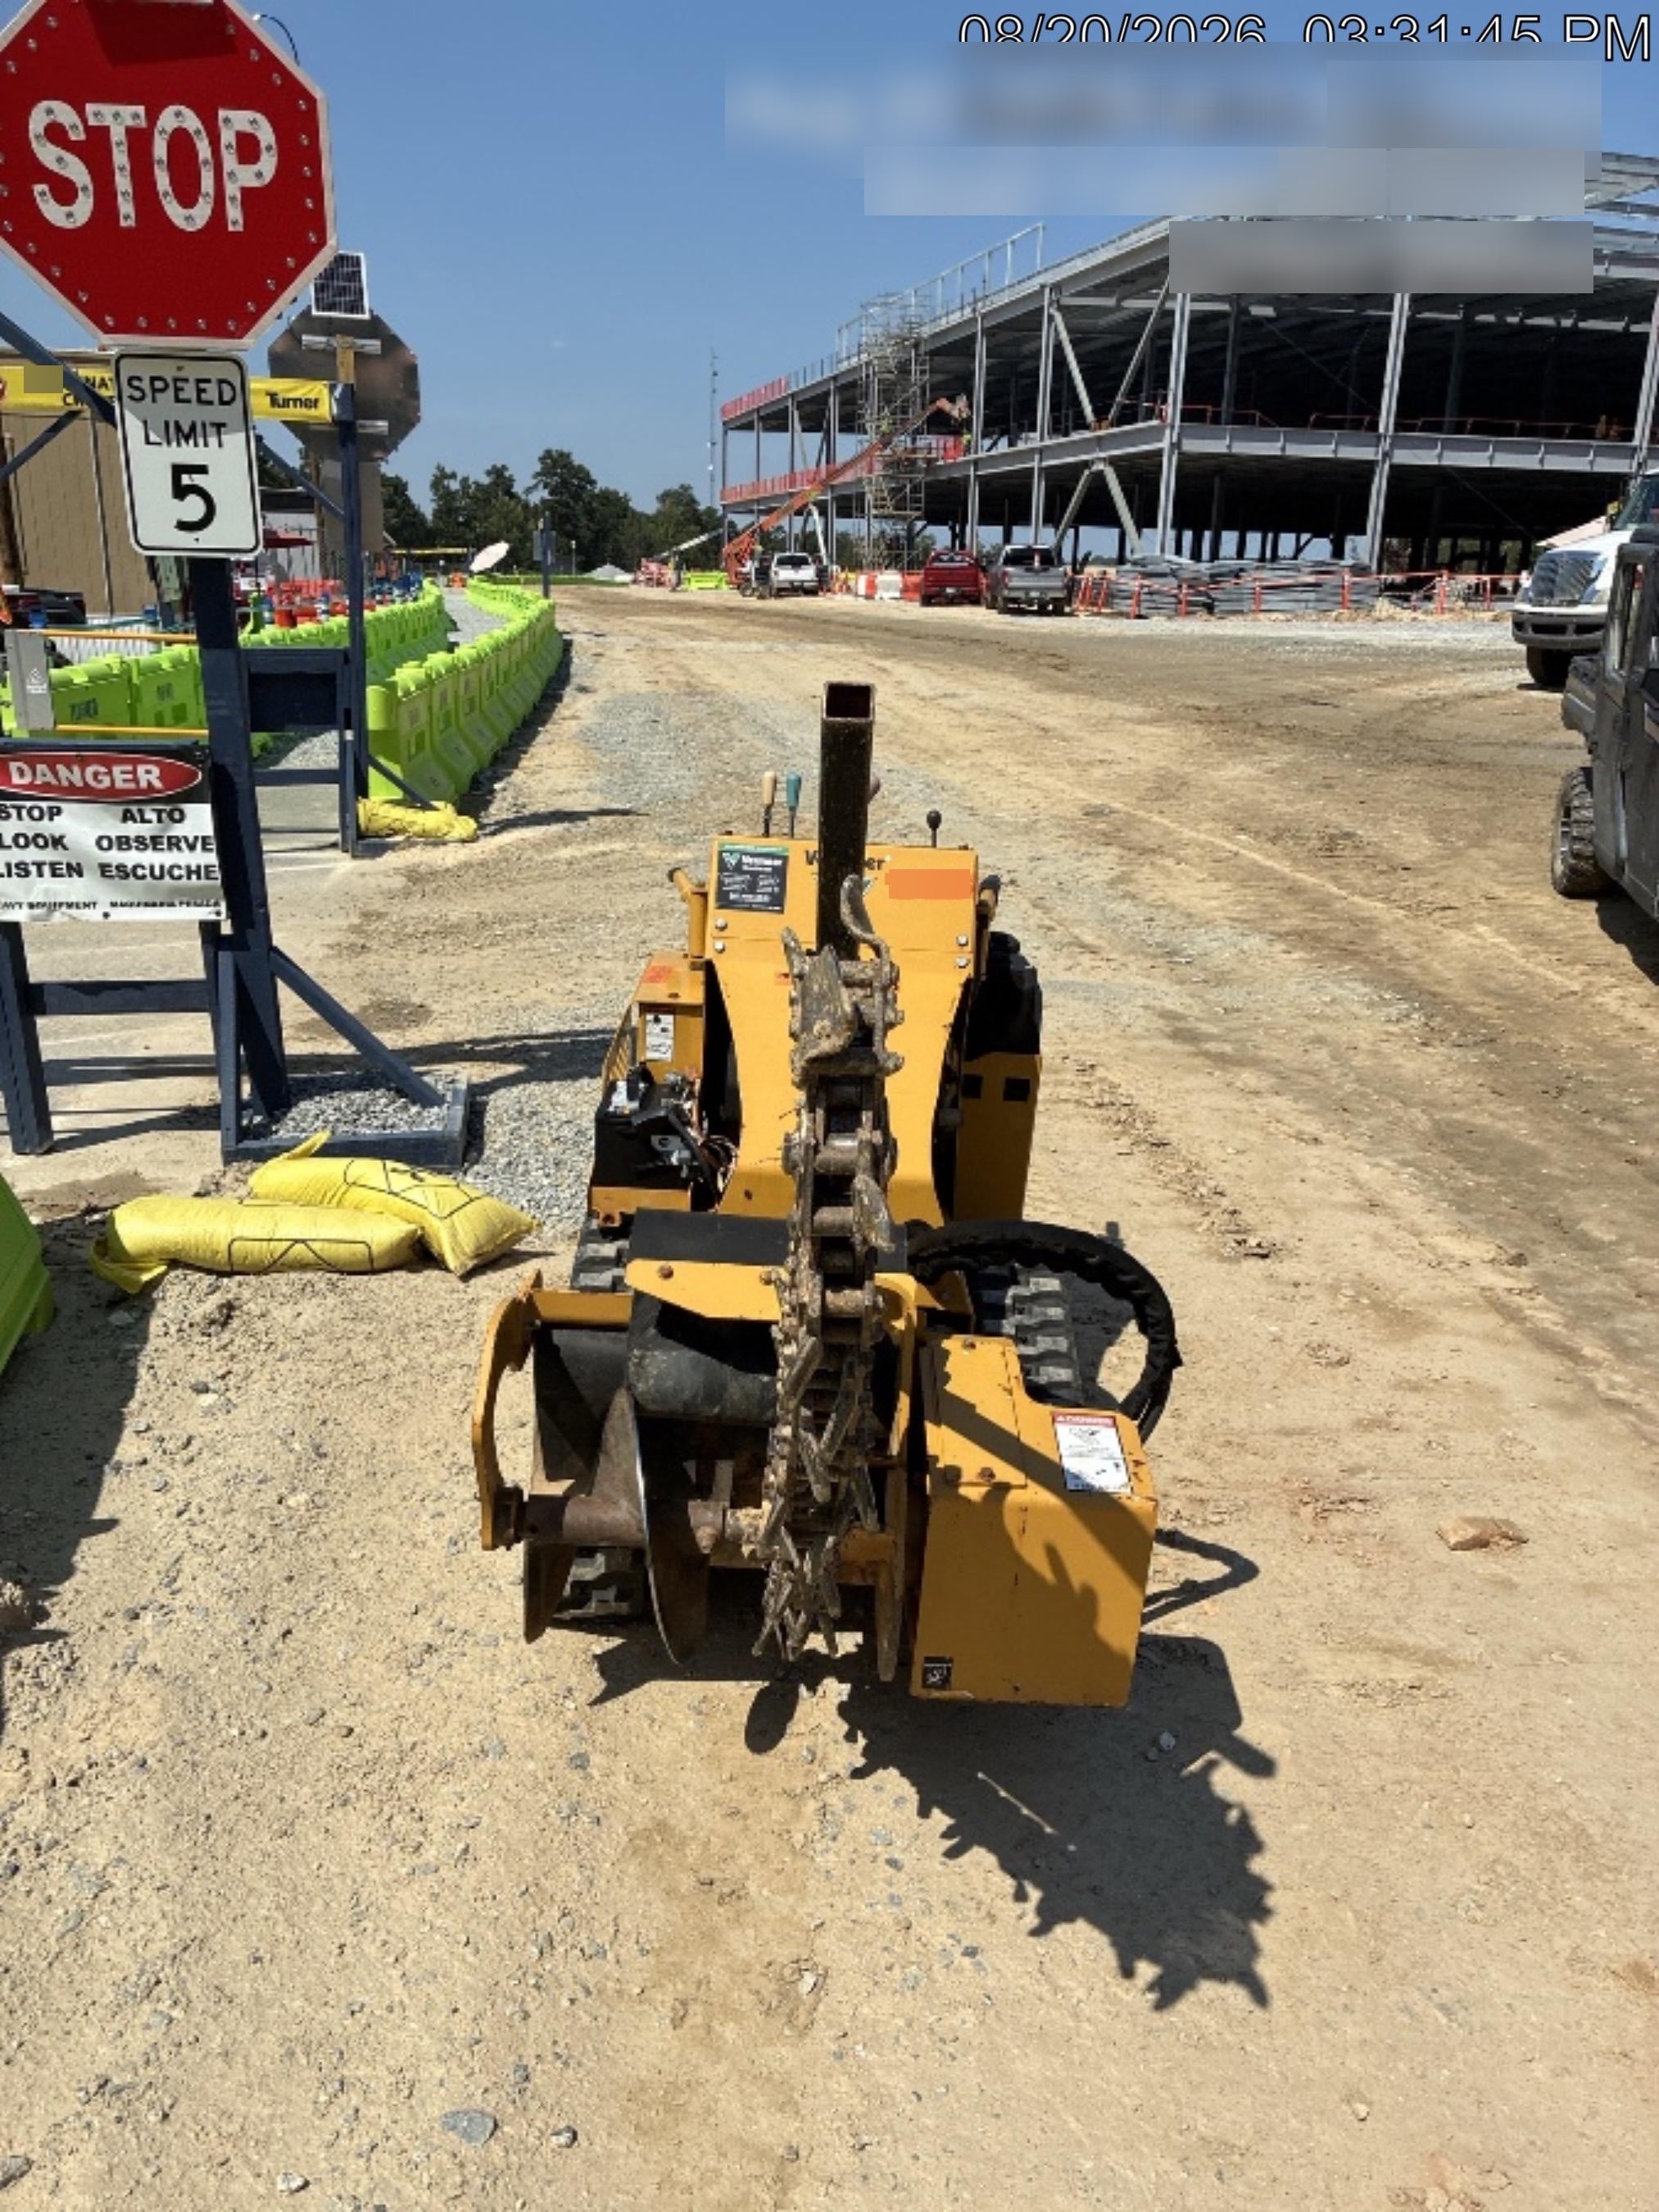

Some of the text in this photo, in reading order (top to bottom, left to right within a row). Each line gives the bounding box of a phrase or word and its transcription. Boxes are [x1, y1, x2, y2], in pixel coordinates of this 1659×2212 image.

[29, 101, 278, 231] STOP
[127, 375, 237, 406] SPEED
[265, 391, 320, 409] Turner
[143, 419, 227, 448] LIMIT
[171, 463, 216, 533] 5
[9, 761, 163, 789] DANGER
[0, 804, 62, 822] STOP
[121, 807, 185, 824] ALTO
[0, 832, 69, 850] LOOK
[95, 835, 215, 852] OBSERVE
[97, 863, 219, 881] ESCUCHE
